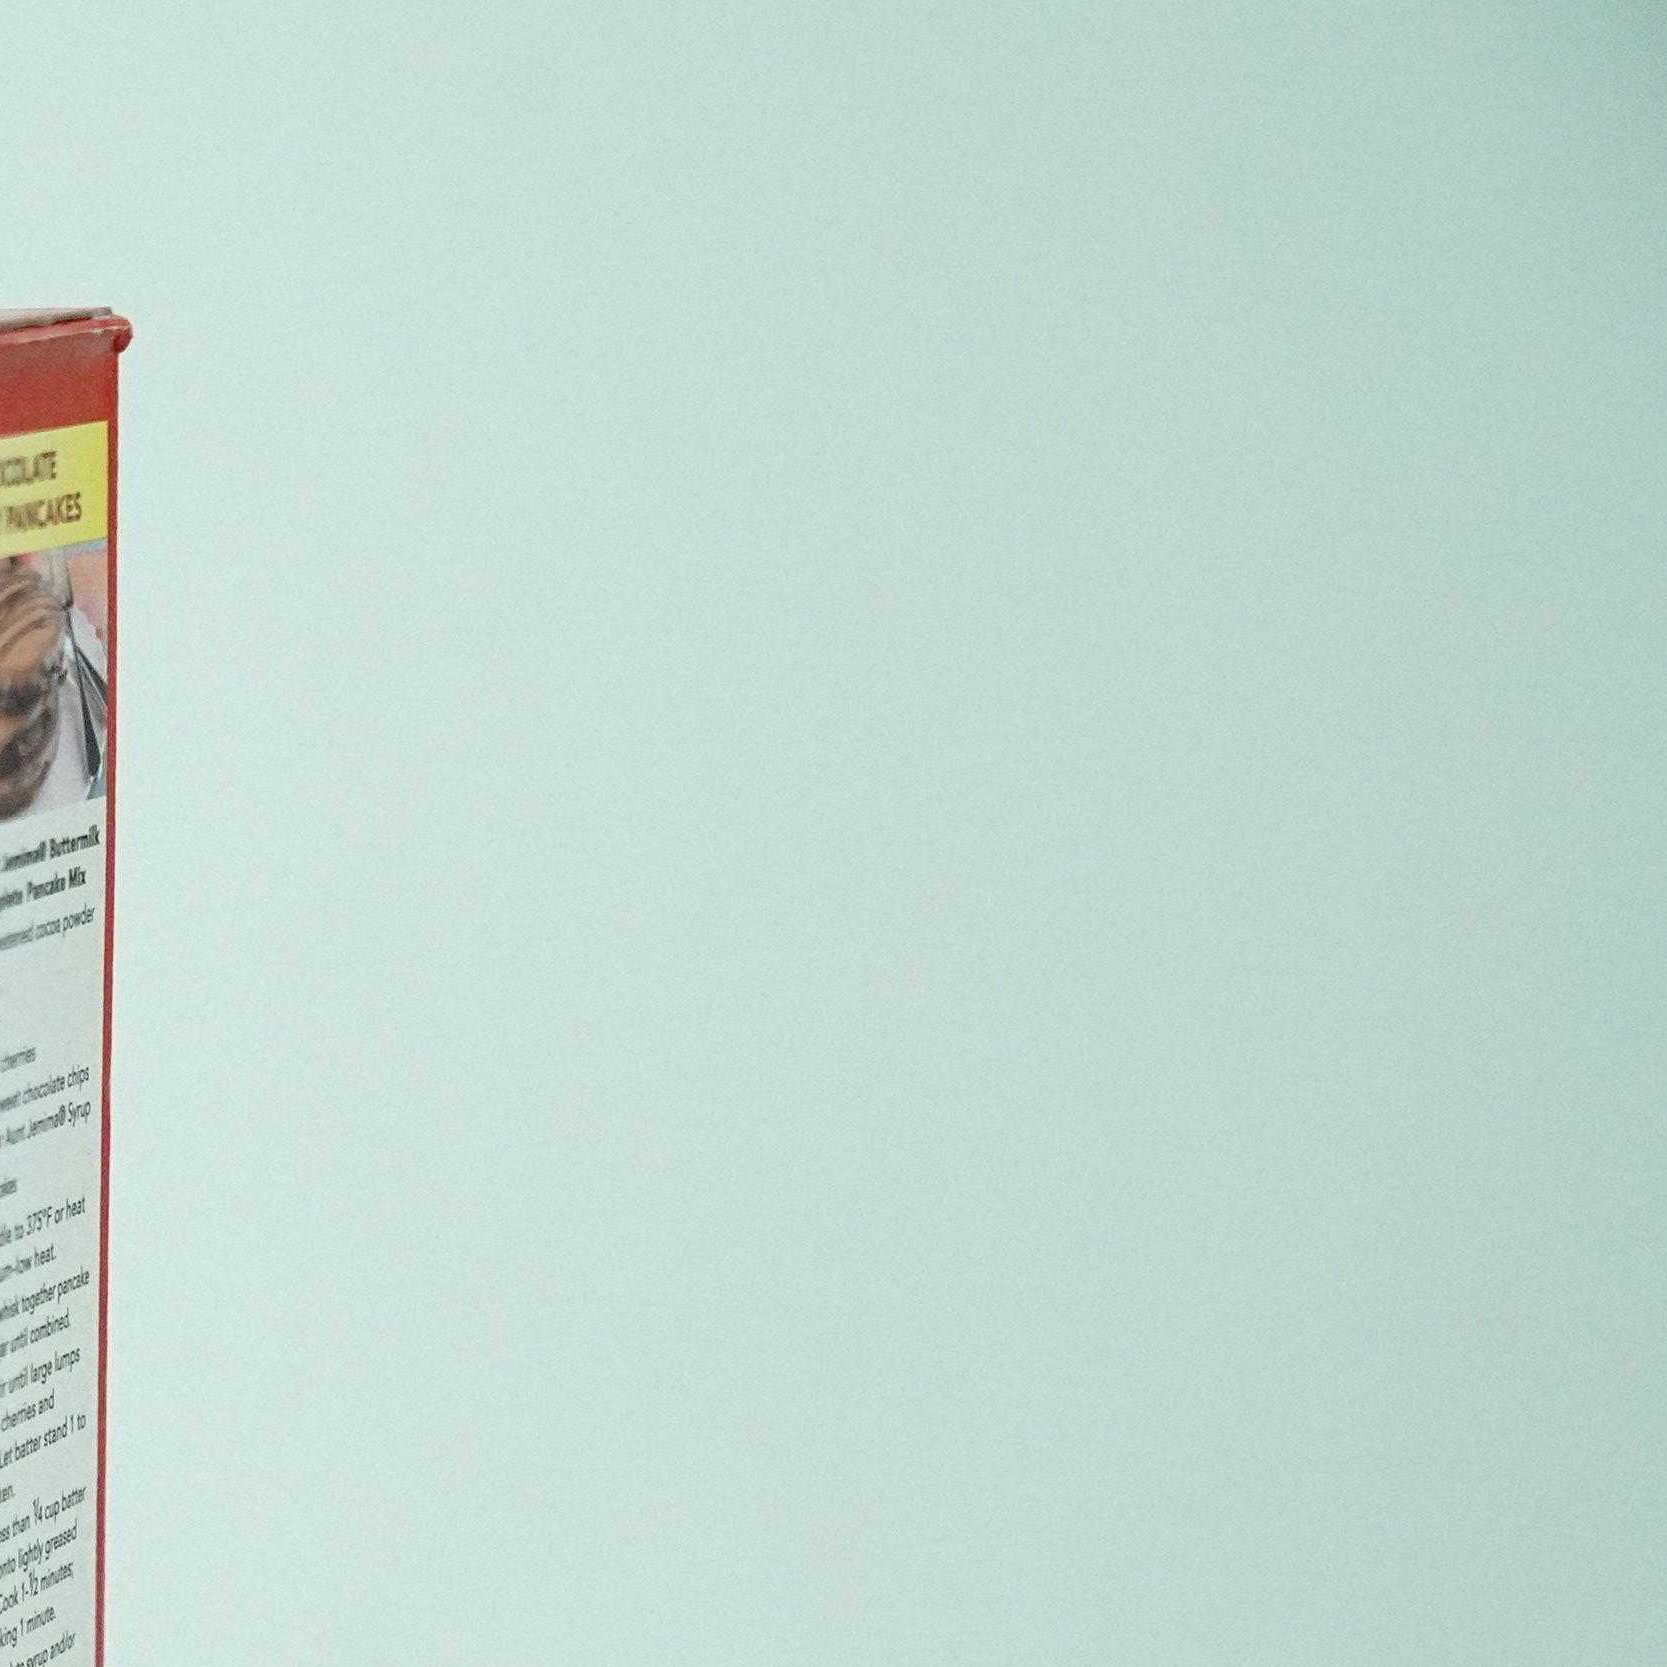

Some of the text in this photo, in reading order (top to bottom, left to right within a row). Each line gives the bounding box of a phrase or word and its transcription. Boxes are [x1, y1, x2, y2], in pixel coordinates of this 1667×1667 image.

[49, 825, 100, 859] Buttermilk
[69, 866, 86, 889] Mix
[62, 903, 95, 937] powder
[67, 1065, 90, 1090] chips
[68, 1101, 91, 1127] Syrup
[54, 1197, 86, 1223] or heat
[57, 1266, 90, 1304] pancake
[30, 1348, 80, 1384] large lumps
[38, 1388, 55, 1414] and
[0, 1431, 42, 1469] Let batter
[44, 1502, 60, 1523] cup
[62, 1487, 86, 1511] batter
[18, 1538, 44, 1571] lightly
[45, 1519, 77, 1560] greased
